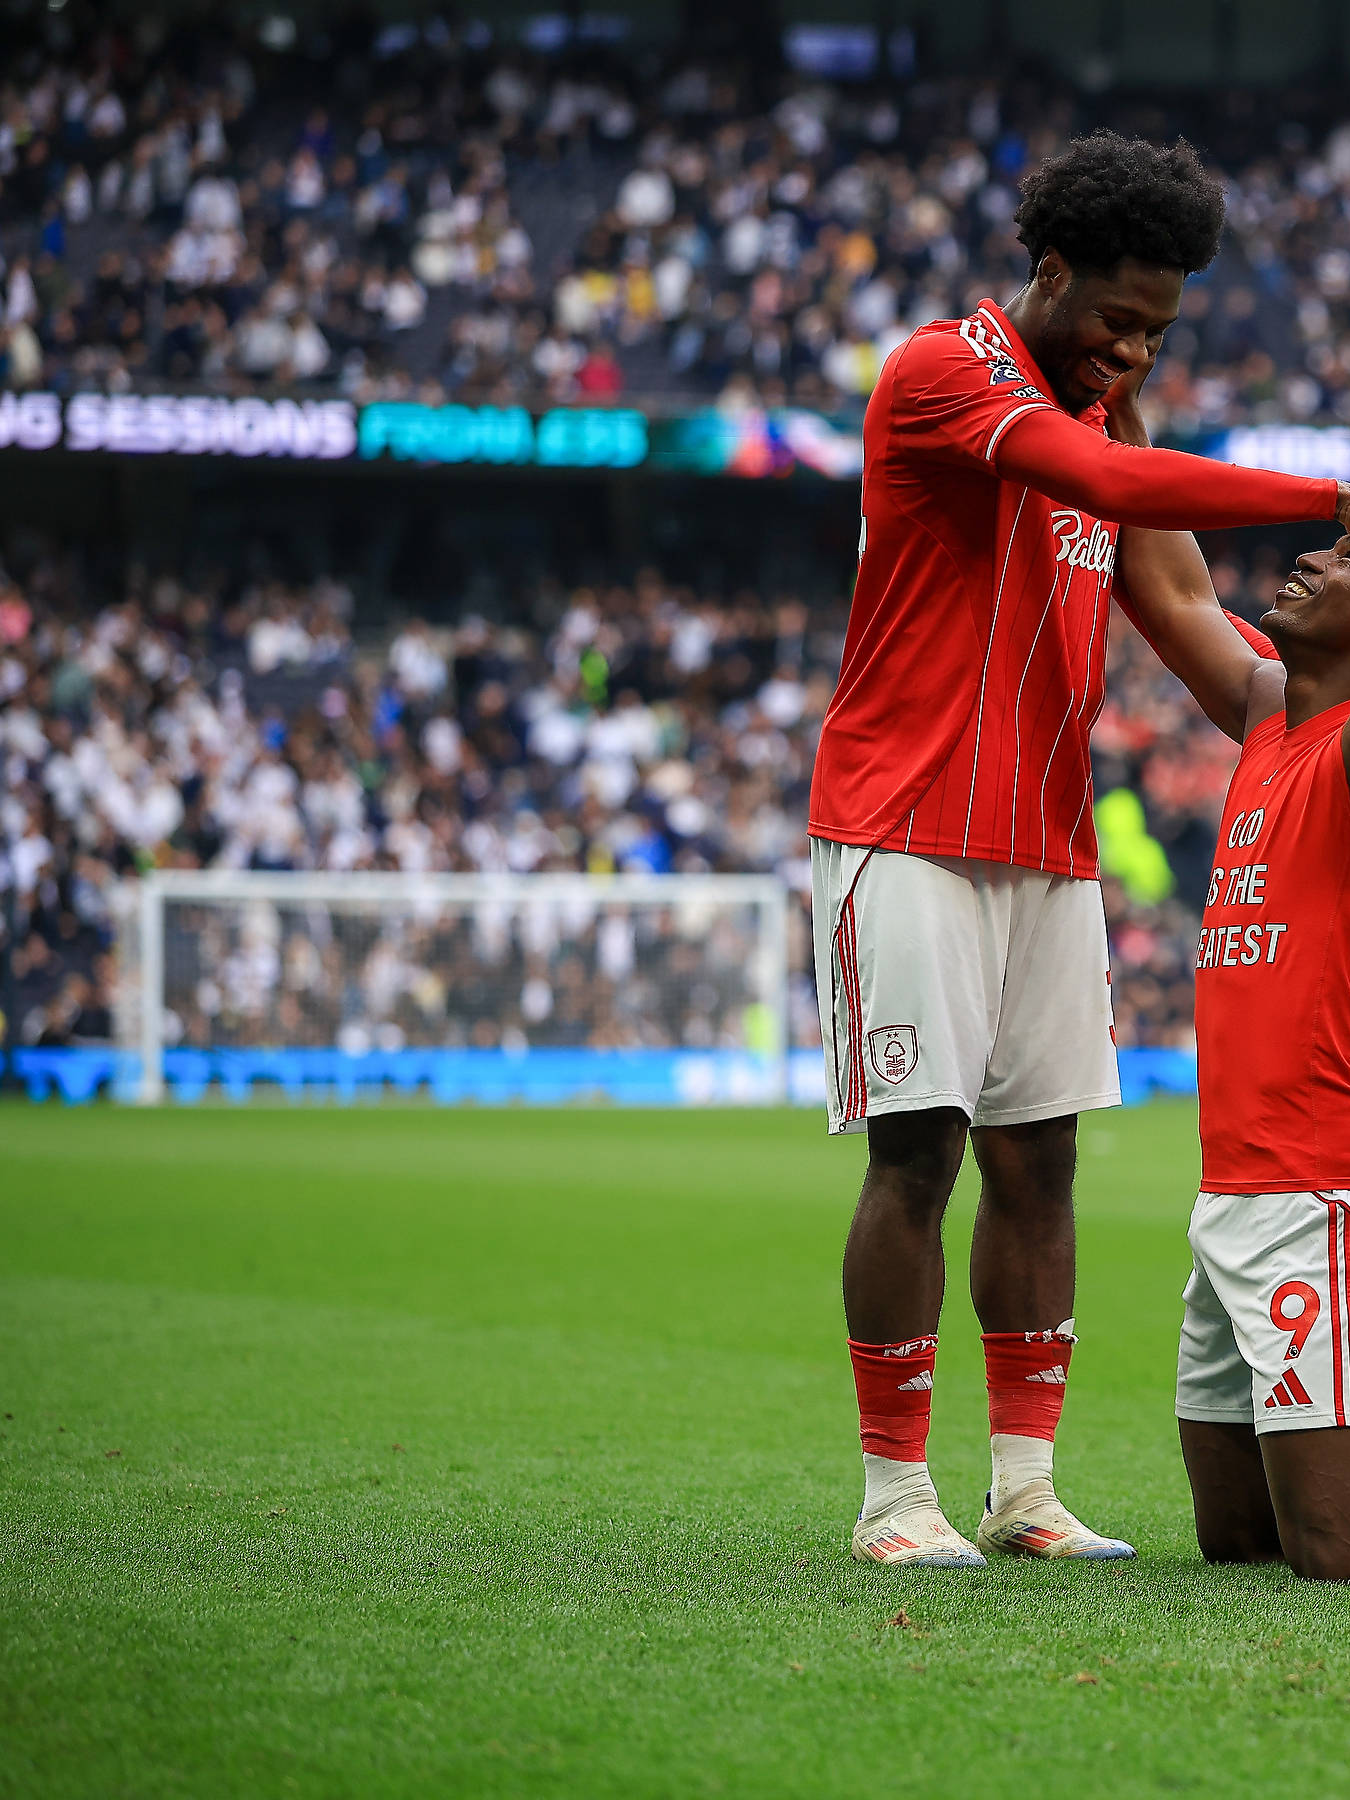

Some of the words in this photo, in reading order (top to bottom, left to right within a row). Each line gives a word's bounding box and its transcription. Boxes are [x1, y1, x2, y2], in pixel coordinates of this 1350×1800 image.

[1228, 808, 1265, 849] GOD
[1223, 864, 1268, 906] THE
[1269, 1280, 1322, 1361] 9
